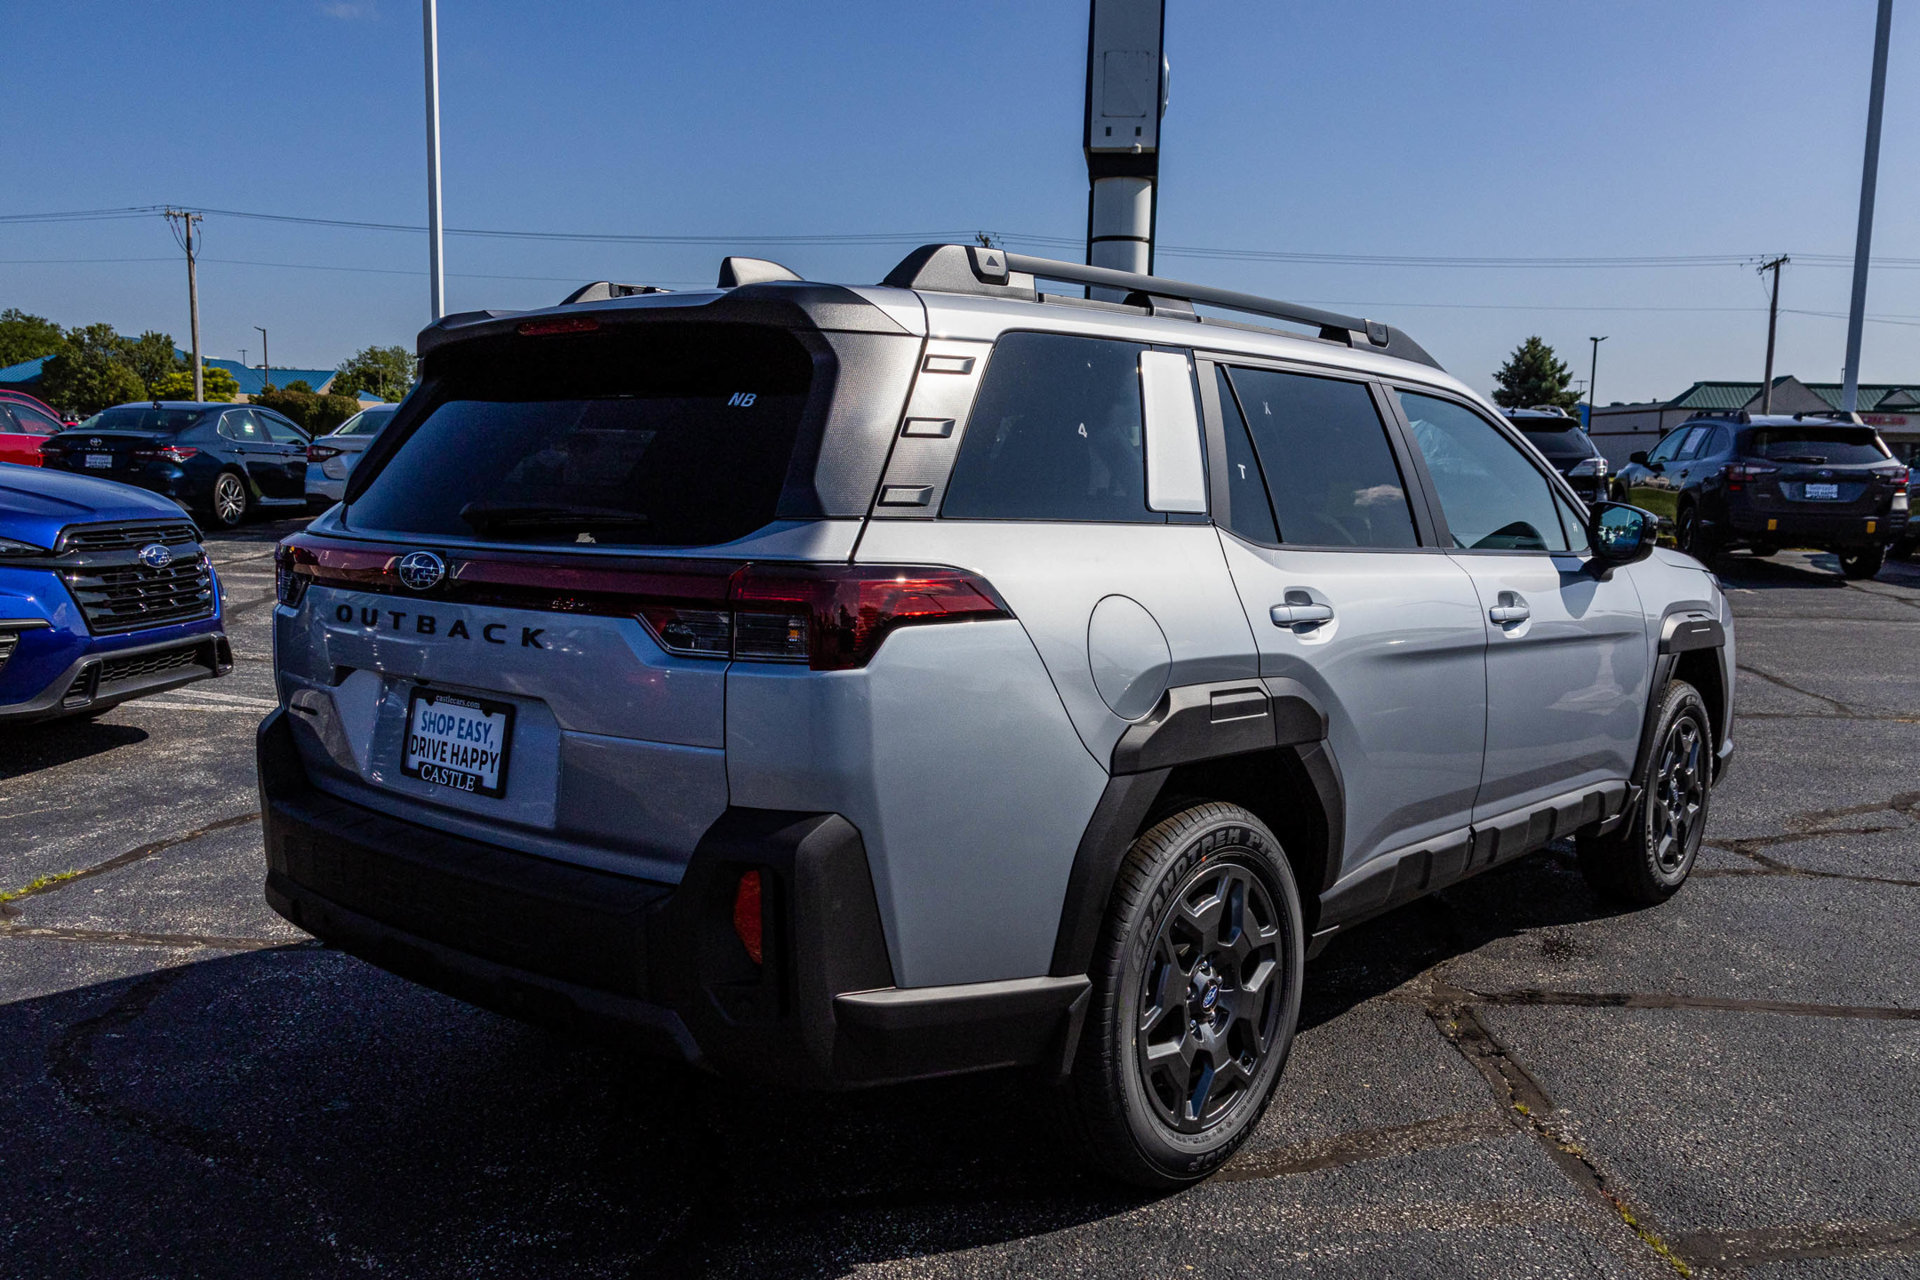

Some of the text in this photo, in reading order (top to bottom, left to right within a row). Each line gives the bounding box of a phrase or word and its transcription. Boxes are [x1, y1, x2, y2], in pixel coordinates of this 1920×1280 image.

[727, 391, 758, 408] NB
[1078, 422, 1088, 438] 4
[1237, 463, 1246, 480] T
[336, 605, 546, 649] OUTBACK
[435, 695, 480, 709] castlecars.com
[421, 710, 494, 749] SHOP EASY,
[410, 734, 500, 774] DRIVE HAPPY
[421, 764, 476, 792] CASTLE
